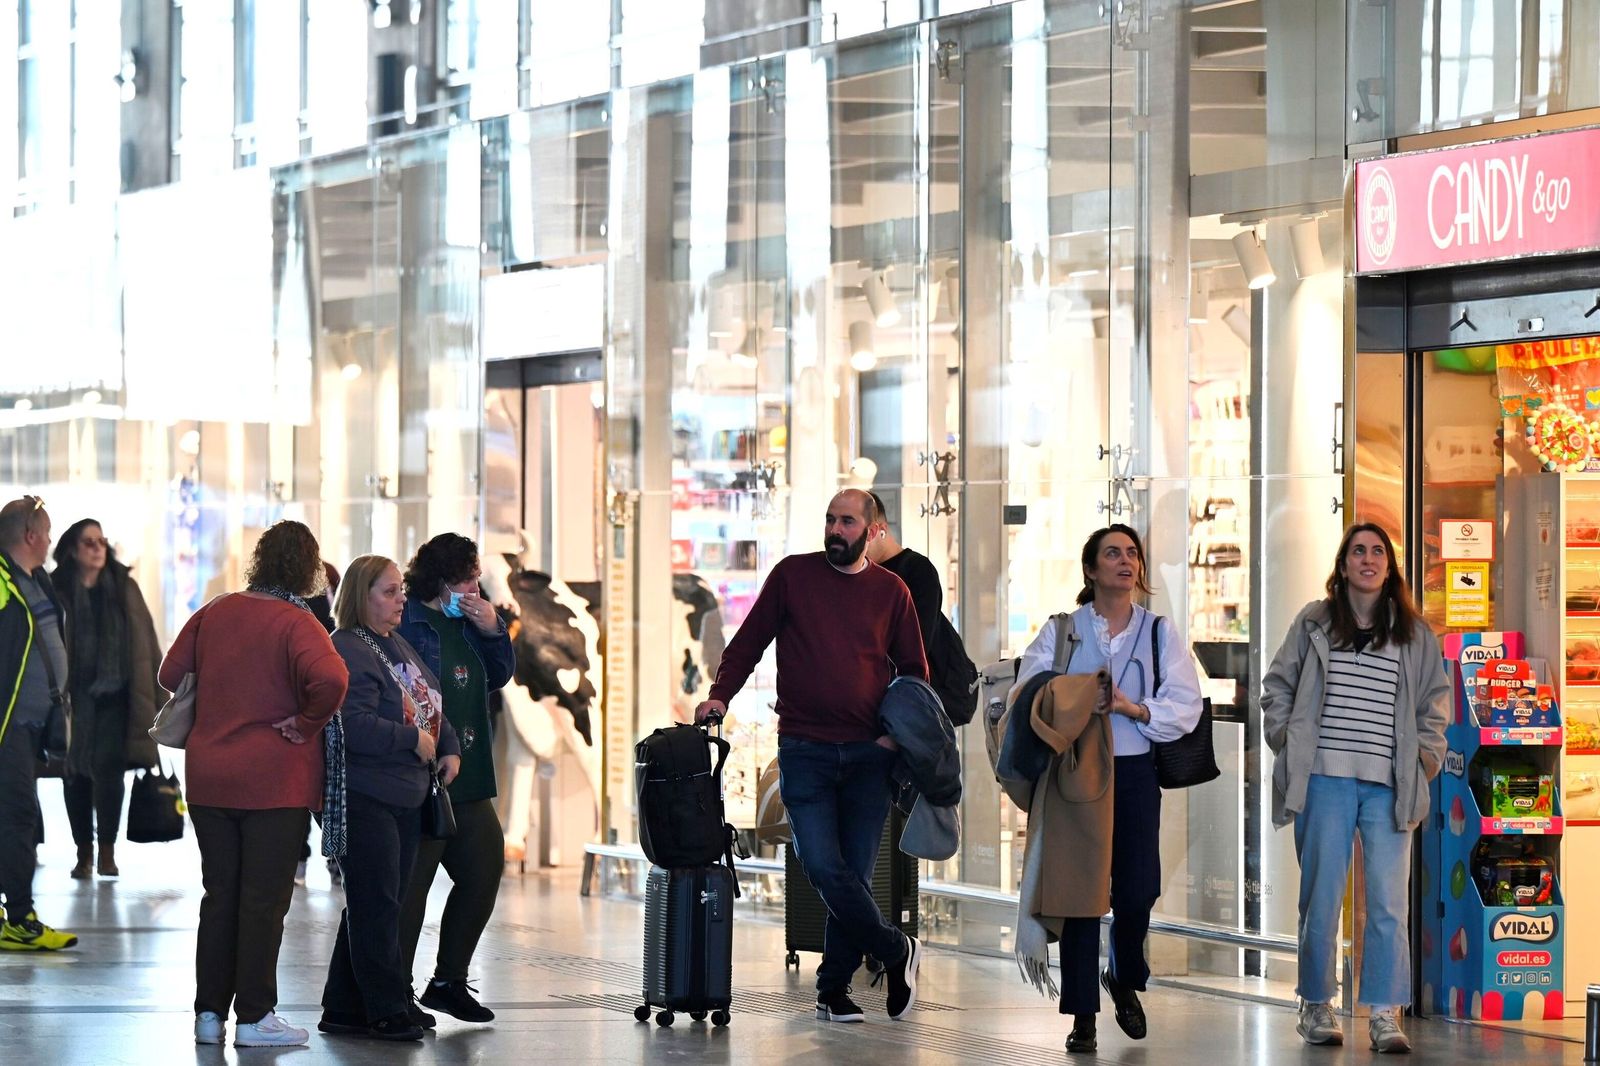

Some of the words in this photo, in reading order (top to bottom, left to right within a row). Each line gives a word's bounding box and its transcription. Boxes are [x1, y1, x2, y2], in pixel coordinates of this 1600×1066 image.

[1427, 154, 1529, 249] CANDY
[1532, 170, 1571, 223] &go
[1465, 649, 1500, 660] VIDAL
[1491, 679, 1521, 688] BURGER
[1446, 756, 1463, 771] VIDAL
[1499, 921, 1550, 935] VIDAL
[1503, 953, 1545, 964] vidal.es
